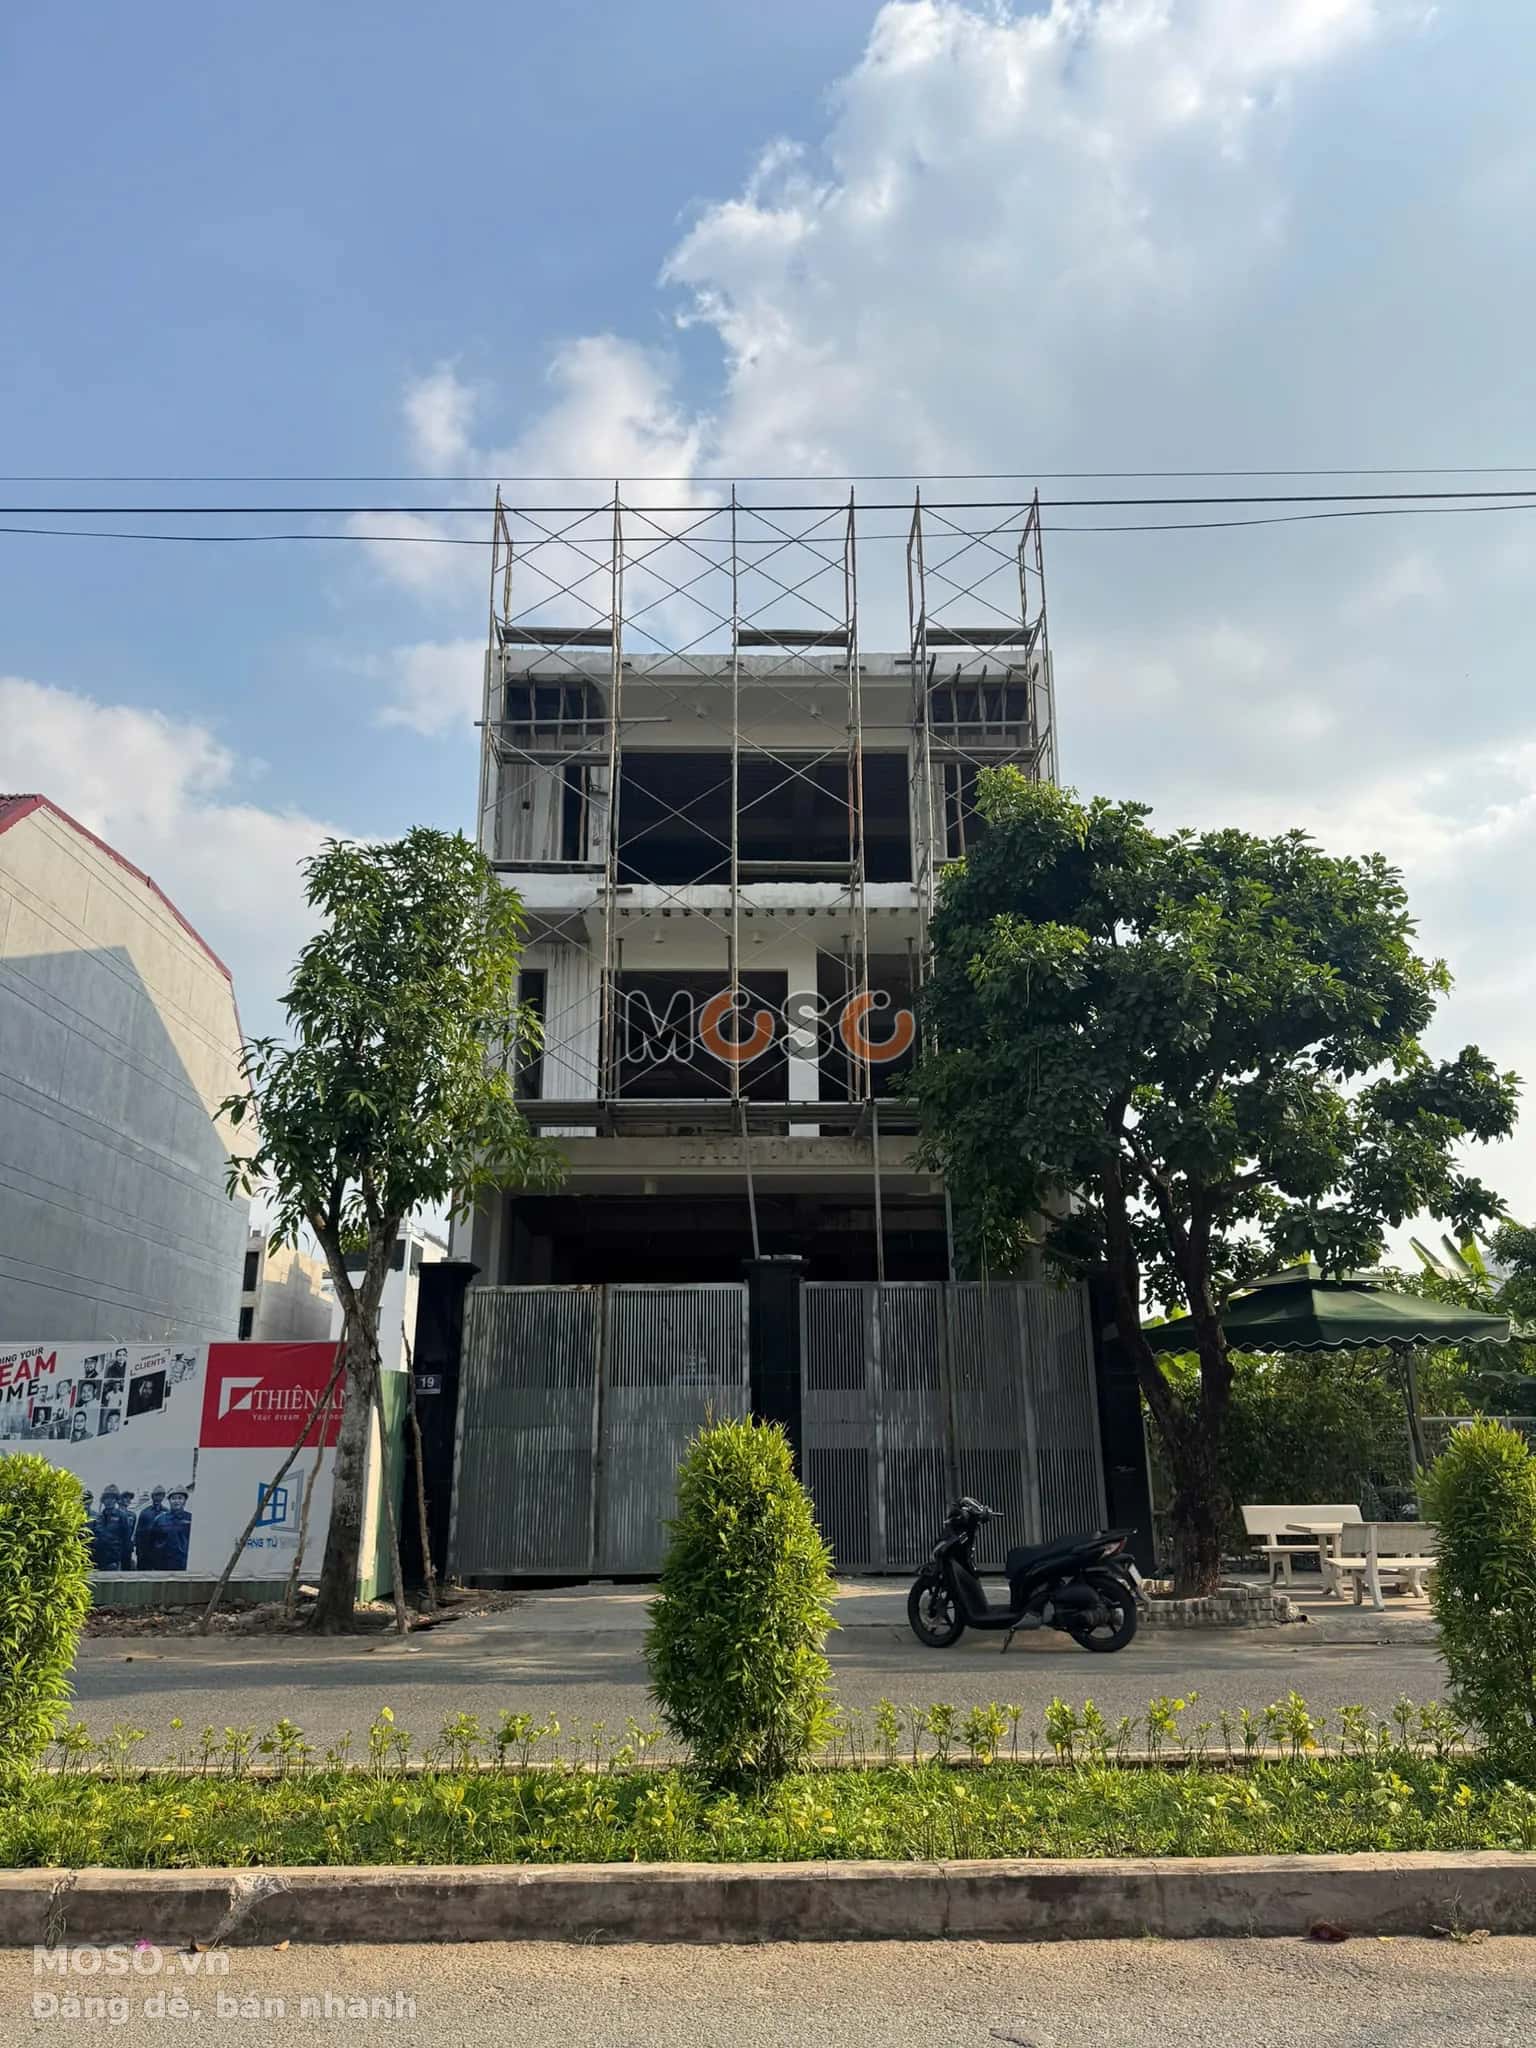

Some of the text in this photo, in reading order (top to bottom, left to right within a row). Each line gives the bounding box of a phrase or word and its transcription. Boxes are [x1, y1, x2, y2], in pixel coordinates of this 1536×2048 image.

[0, 1346, 44, 1365] ING YOUR
[420, 1376, 435, 1388] 19
[253, 1384, 320, 1410] THIÊN
